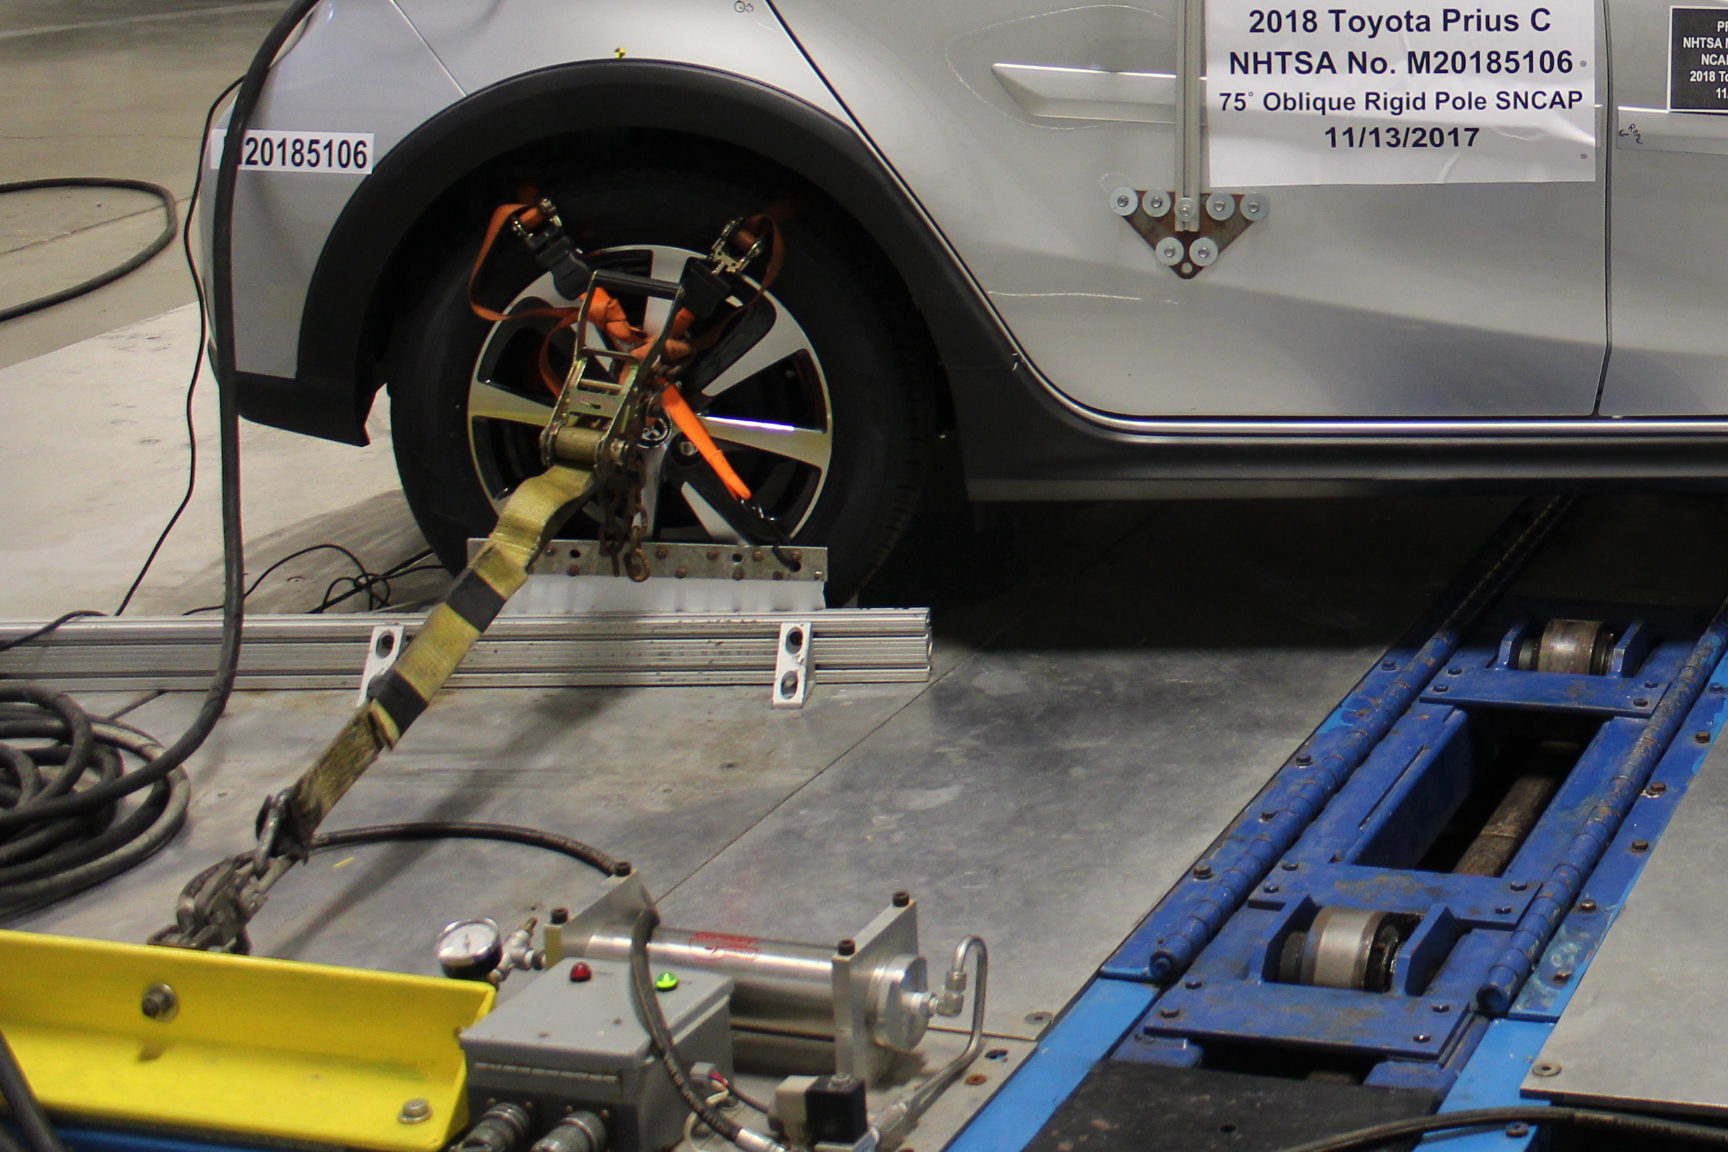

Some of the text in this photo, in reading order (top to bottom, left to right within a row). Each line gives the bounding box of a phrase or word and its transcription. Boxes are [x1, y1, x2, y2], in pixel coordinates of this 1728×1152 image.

[1249, 7, 1551, 39] 2018 Toyota Prius C
[1683, 37, 1723, 50] NHTSA
[1229, 49, 1573, 75] NHTSA No. M20185106
[1689, 70, 1716, 83] 2018
[1263, 91, 1356, 116] Oblique
[1365, 91, 1426, 116] Rigid
[1435, 91, 1487, 111] Pole
[1495, 90, 1584, 110] SNCAP
[1324, 126, 1480, 149] 11/13/2017
[224, 136, 368, 169] 20185106
